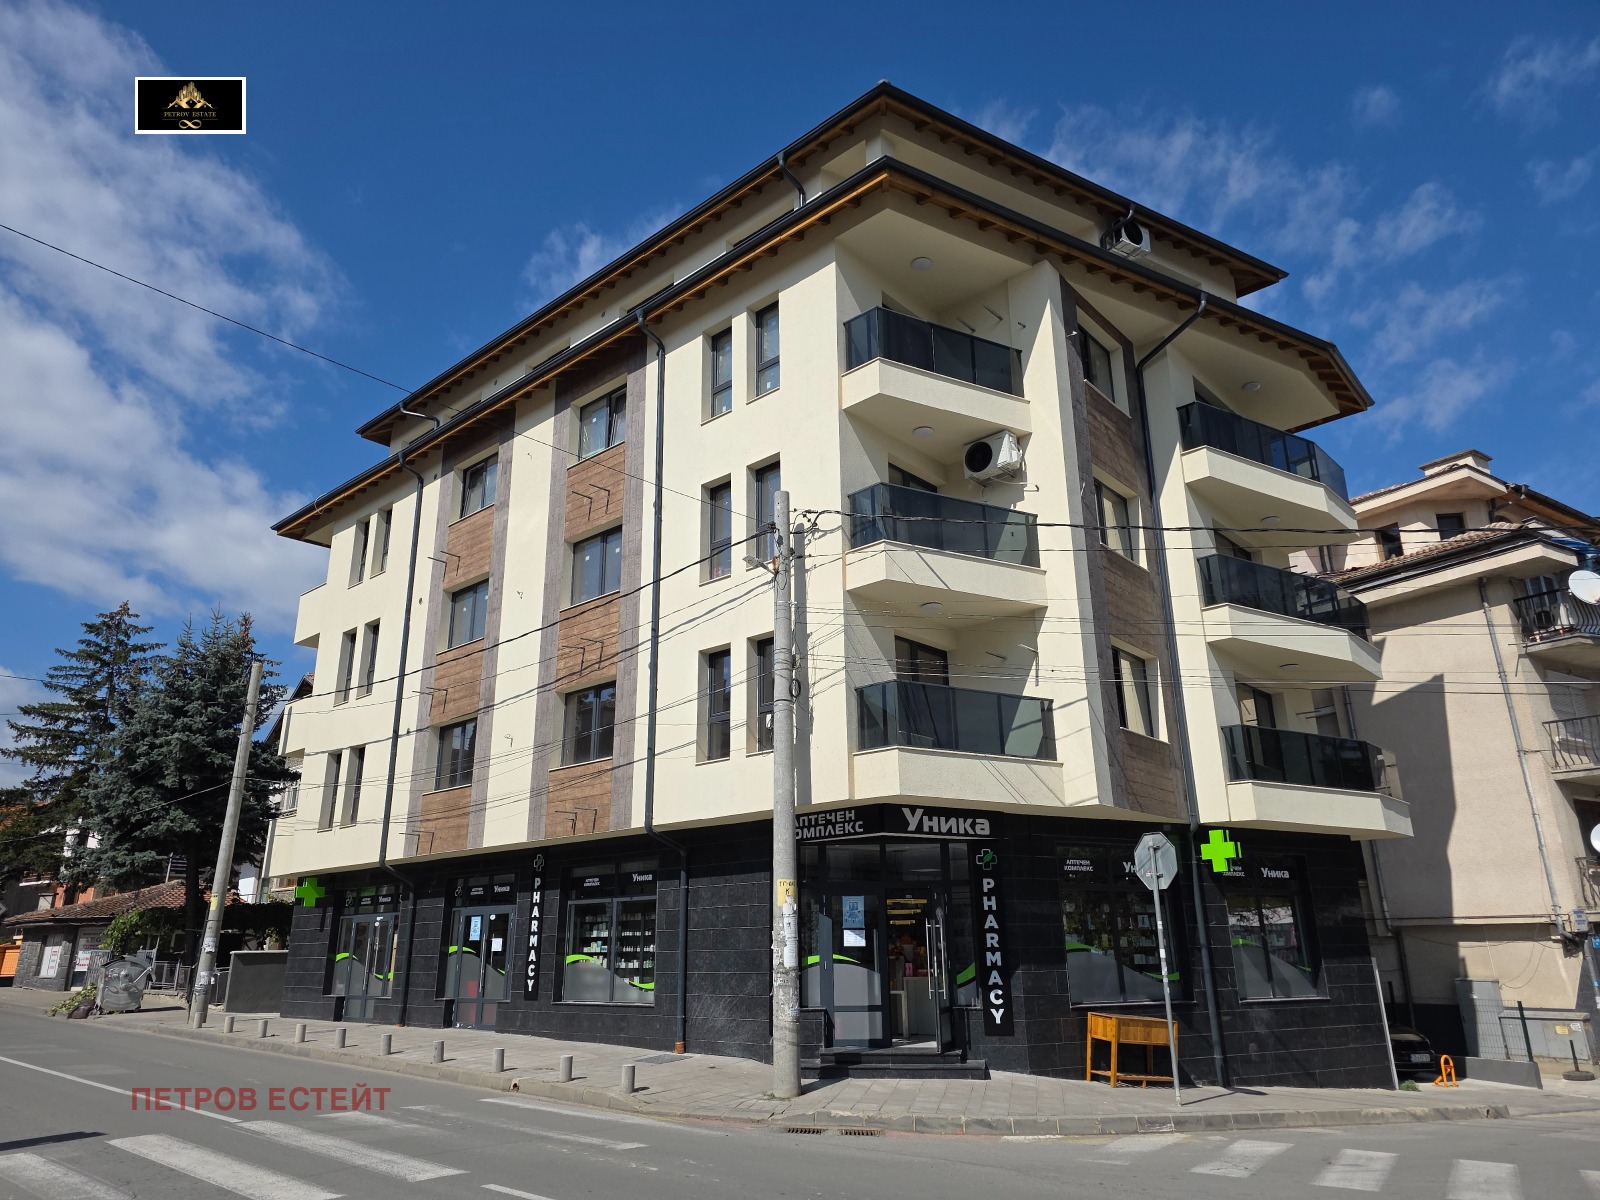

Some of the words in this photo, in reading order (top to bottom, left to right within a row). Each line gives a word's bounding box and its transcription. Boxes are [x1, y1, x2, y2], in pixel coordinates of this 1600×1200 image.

[795, 820, 864, 840] ОМПЛЕКС
[901, 807, 991, 835] Уника
[632, 873, 653, 882] Уника
[1260, 867, 1290, 879] Уника
[526, 877, 541, 992] PHARMACY
[982, 878, 1005, 1024] PHARMACY
